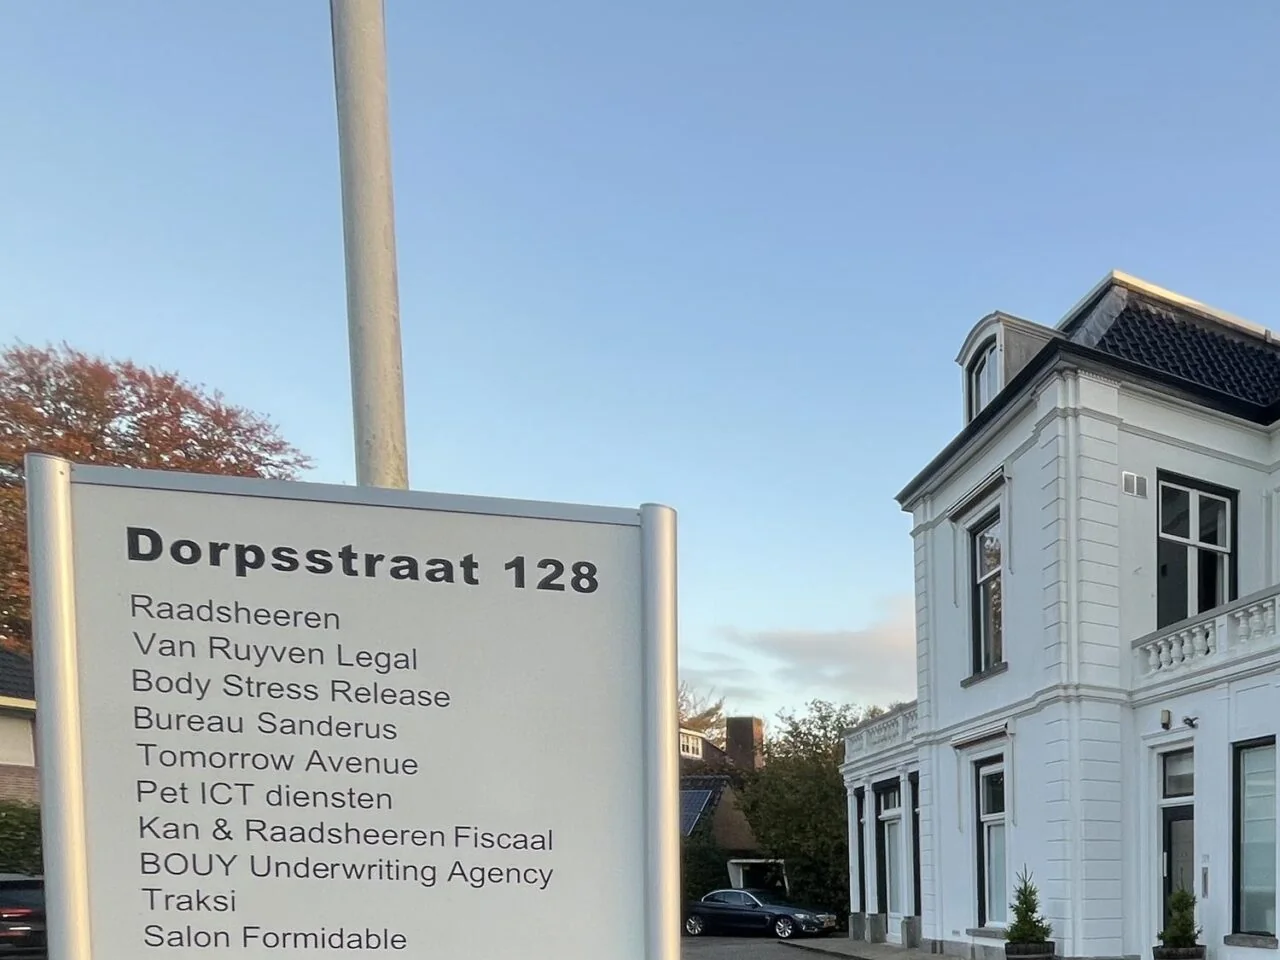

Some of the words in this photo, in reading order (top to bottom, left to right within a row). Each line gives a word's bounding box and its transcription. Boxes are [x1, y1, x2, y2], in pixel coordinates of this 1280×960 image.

[127, 526, 480, 586] Dorpsstraat
[504, 555, 599, 594] 128
[130, 593, 340, 630] Raadsheeren
[132, 631, 196, 659] Van
[208, 635, 324, 668] Ruyven
[337, 643, 417, 675] Legal
[132, 668, 212, 701] Body
[222, 673, 319, 701] Stress
[331, 679, 451, 708] Release
[133, 705, 244, 734] Bureau
[257, 711, 398, 740] Sanderus
[135, 742, 295, 772] Tomorrow
[304, 749, 418, 776] Avenue
[136, 779, 190, 804] Pet
[201, 781, 255, 806] ICT
[265, 784, 392, 810] diensten
[139, 815, 200, 841] Kan
[212, 817, 234, 841] &
[245, 818, 445, 847] Raadsheeren
[454, 825, 553, 851] Fiscaal
[140, 852, 238, 877] BOUY
[250, 854, 437, 888] Underwriting
[447, 860, 554, 890] Agency
[141, 887, 236, 912] Traksi
[143, 924, 230, 949] Salon
[243, 925, 407, 951] Formidable
